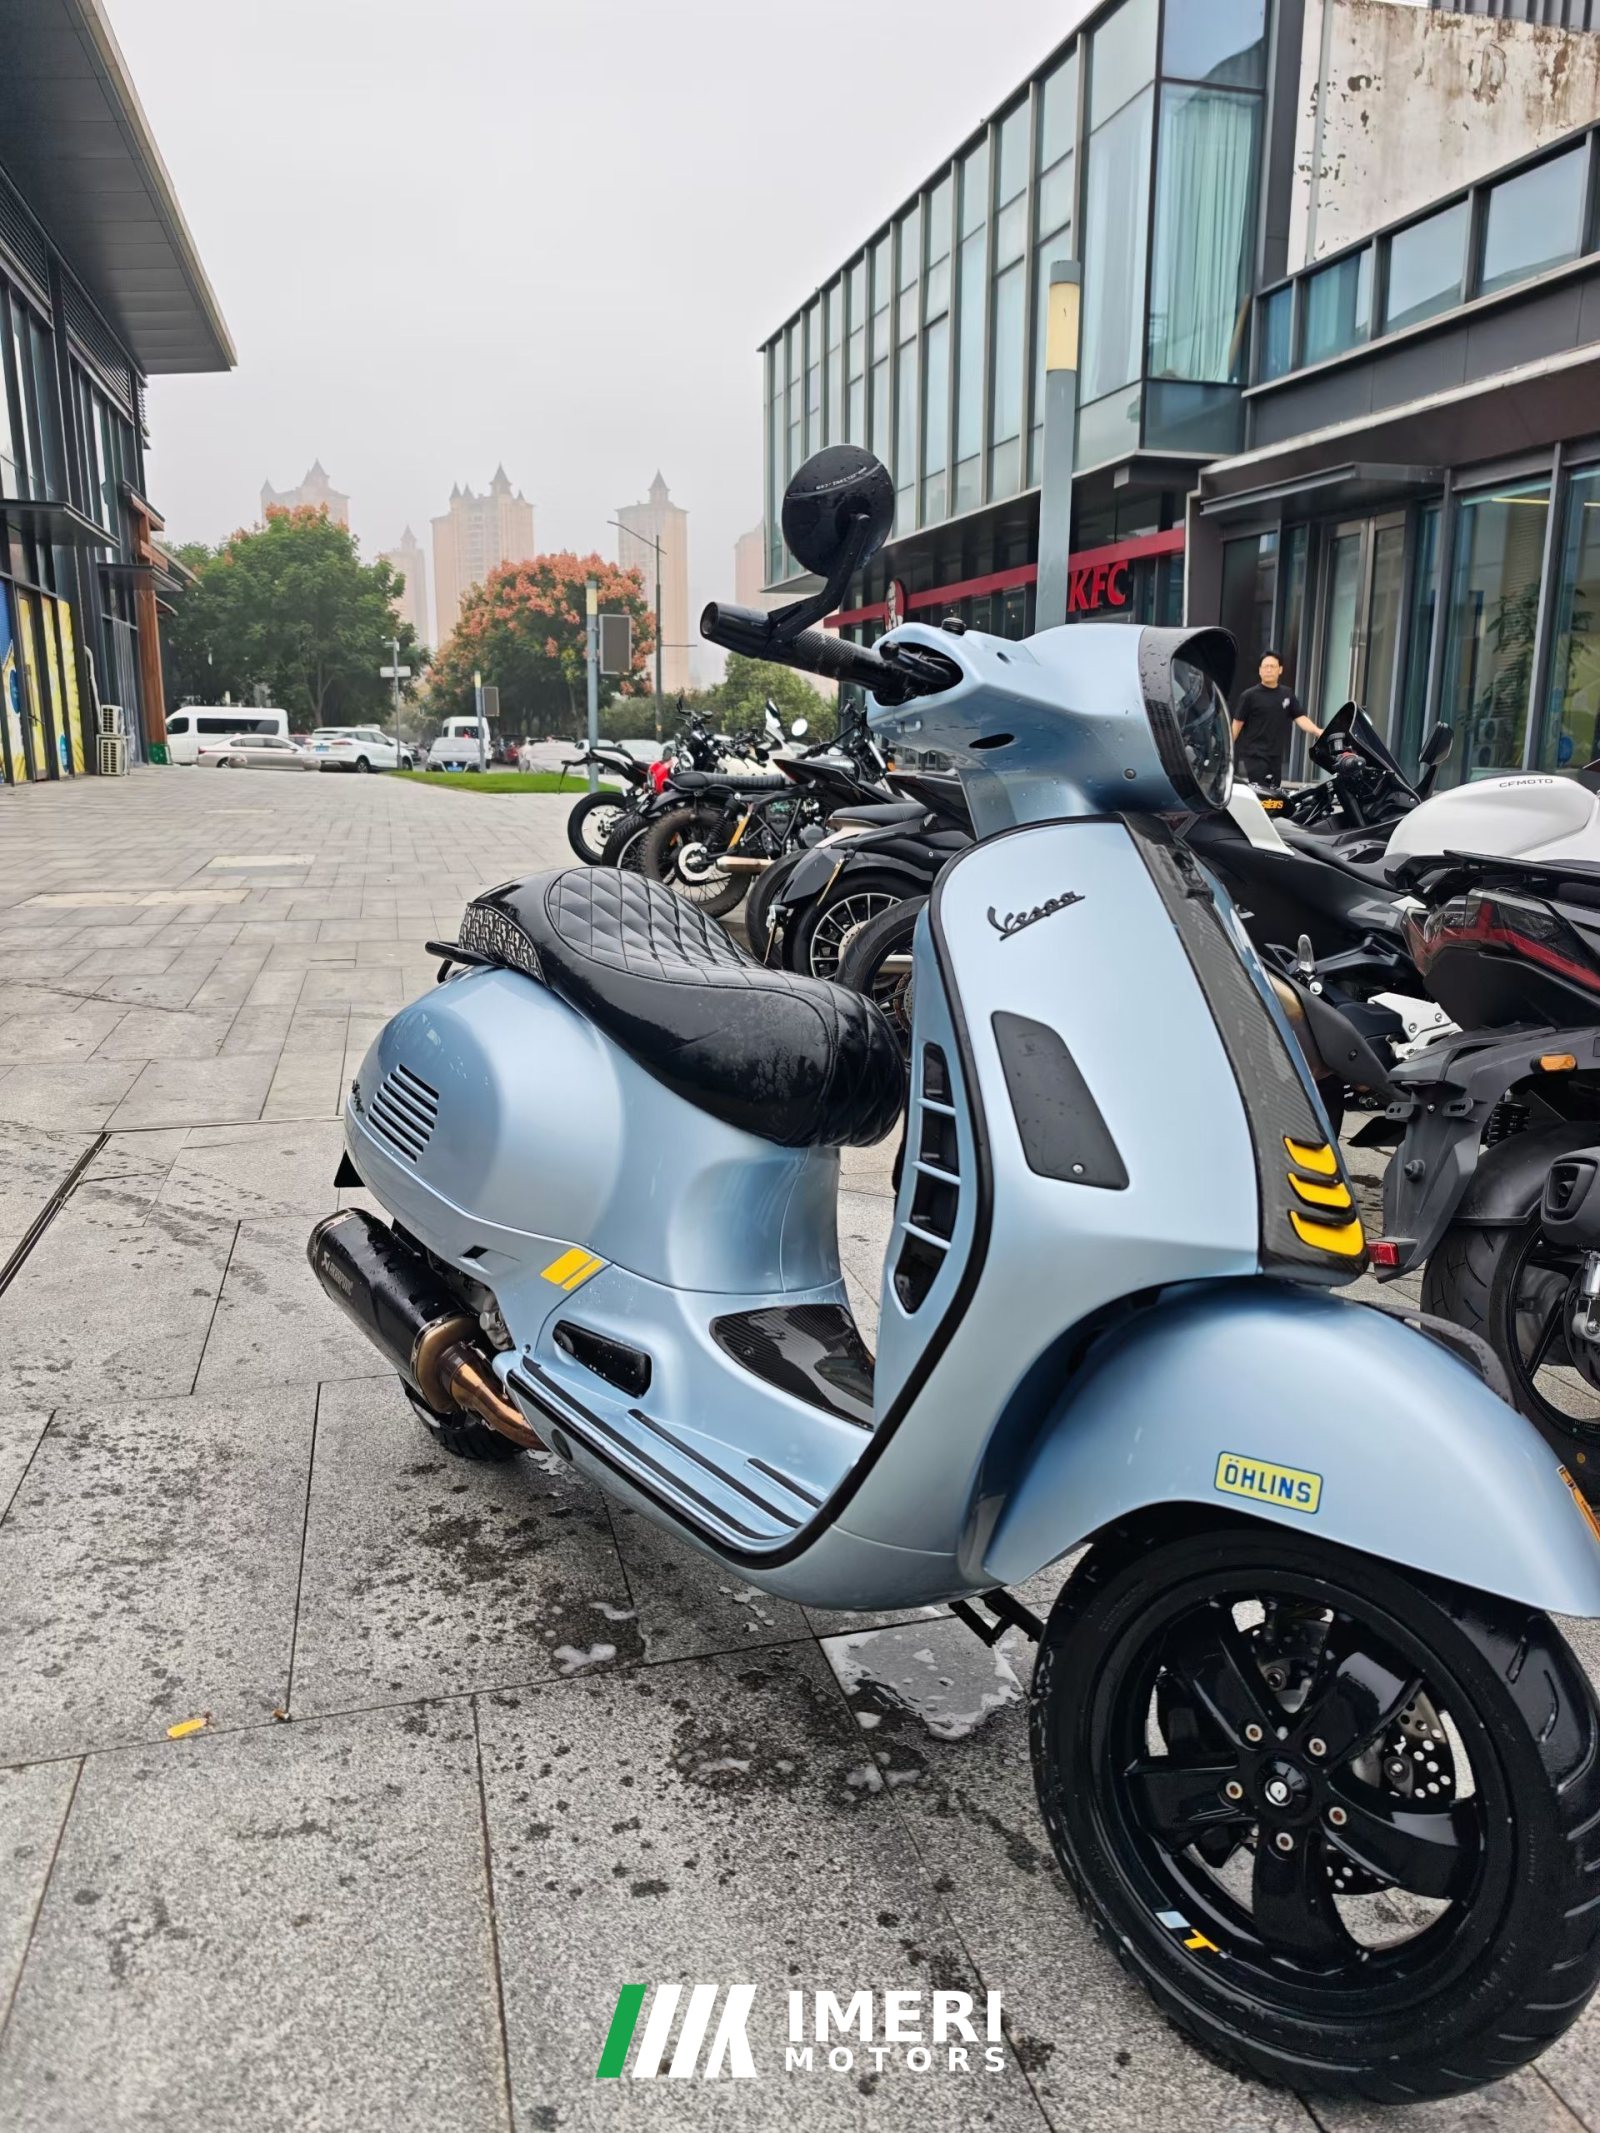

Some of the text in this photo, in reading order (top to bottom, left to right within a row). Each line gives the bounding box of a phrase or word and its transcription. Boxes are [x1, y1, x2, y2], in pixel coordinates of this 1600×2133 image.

[1068, 560, 1129, 612] KFC
[1498, 778, 1554, 788] CFMOTO
[986, 890, 1086, 942] Vespa
[1224, 1458, 1312, 1503] ÖHLINS
